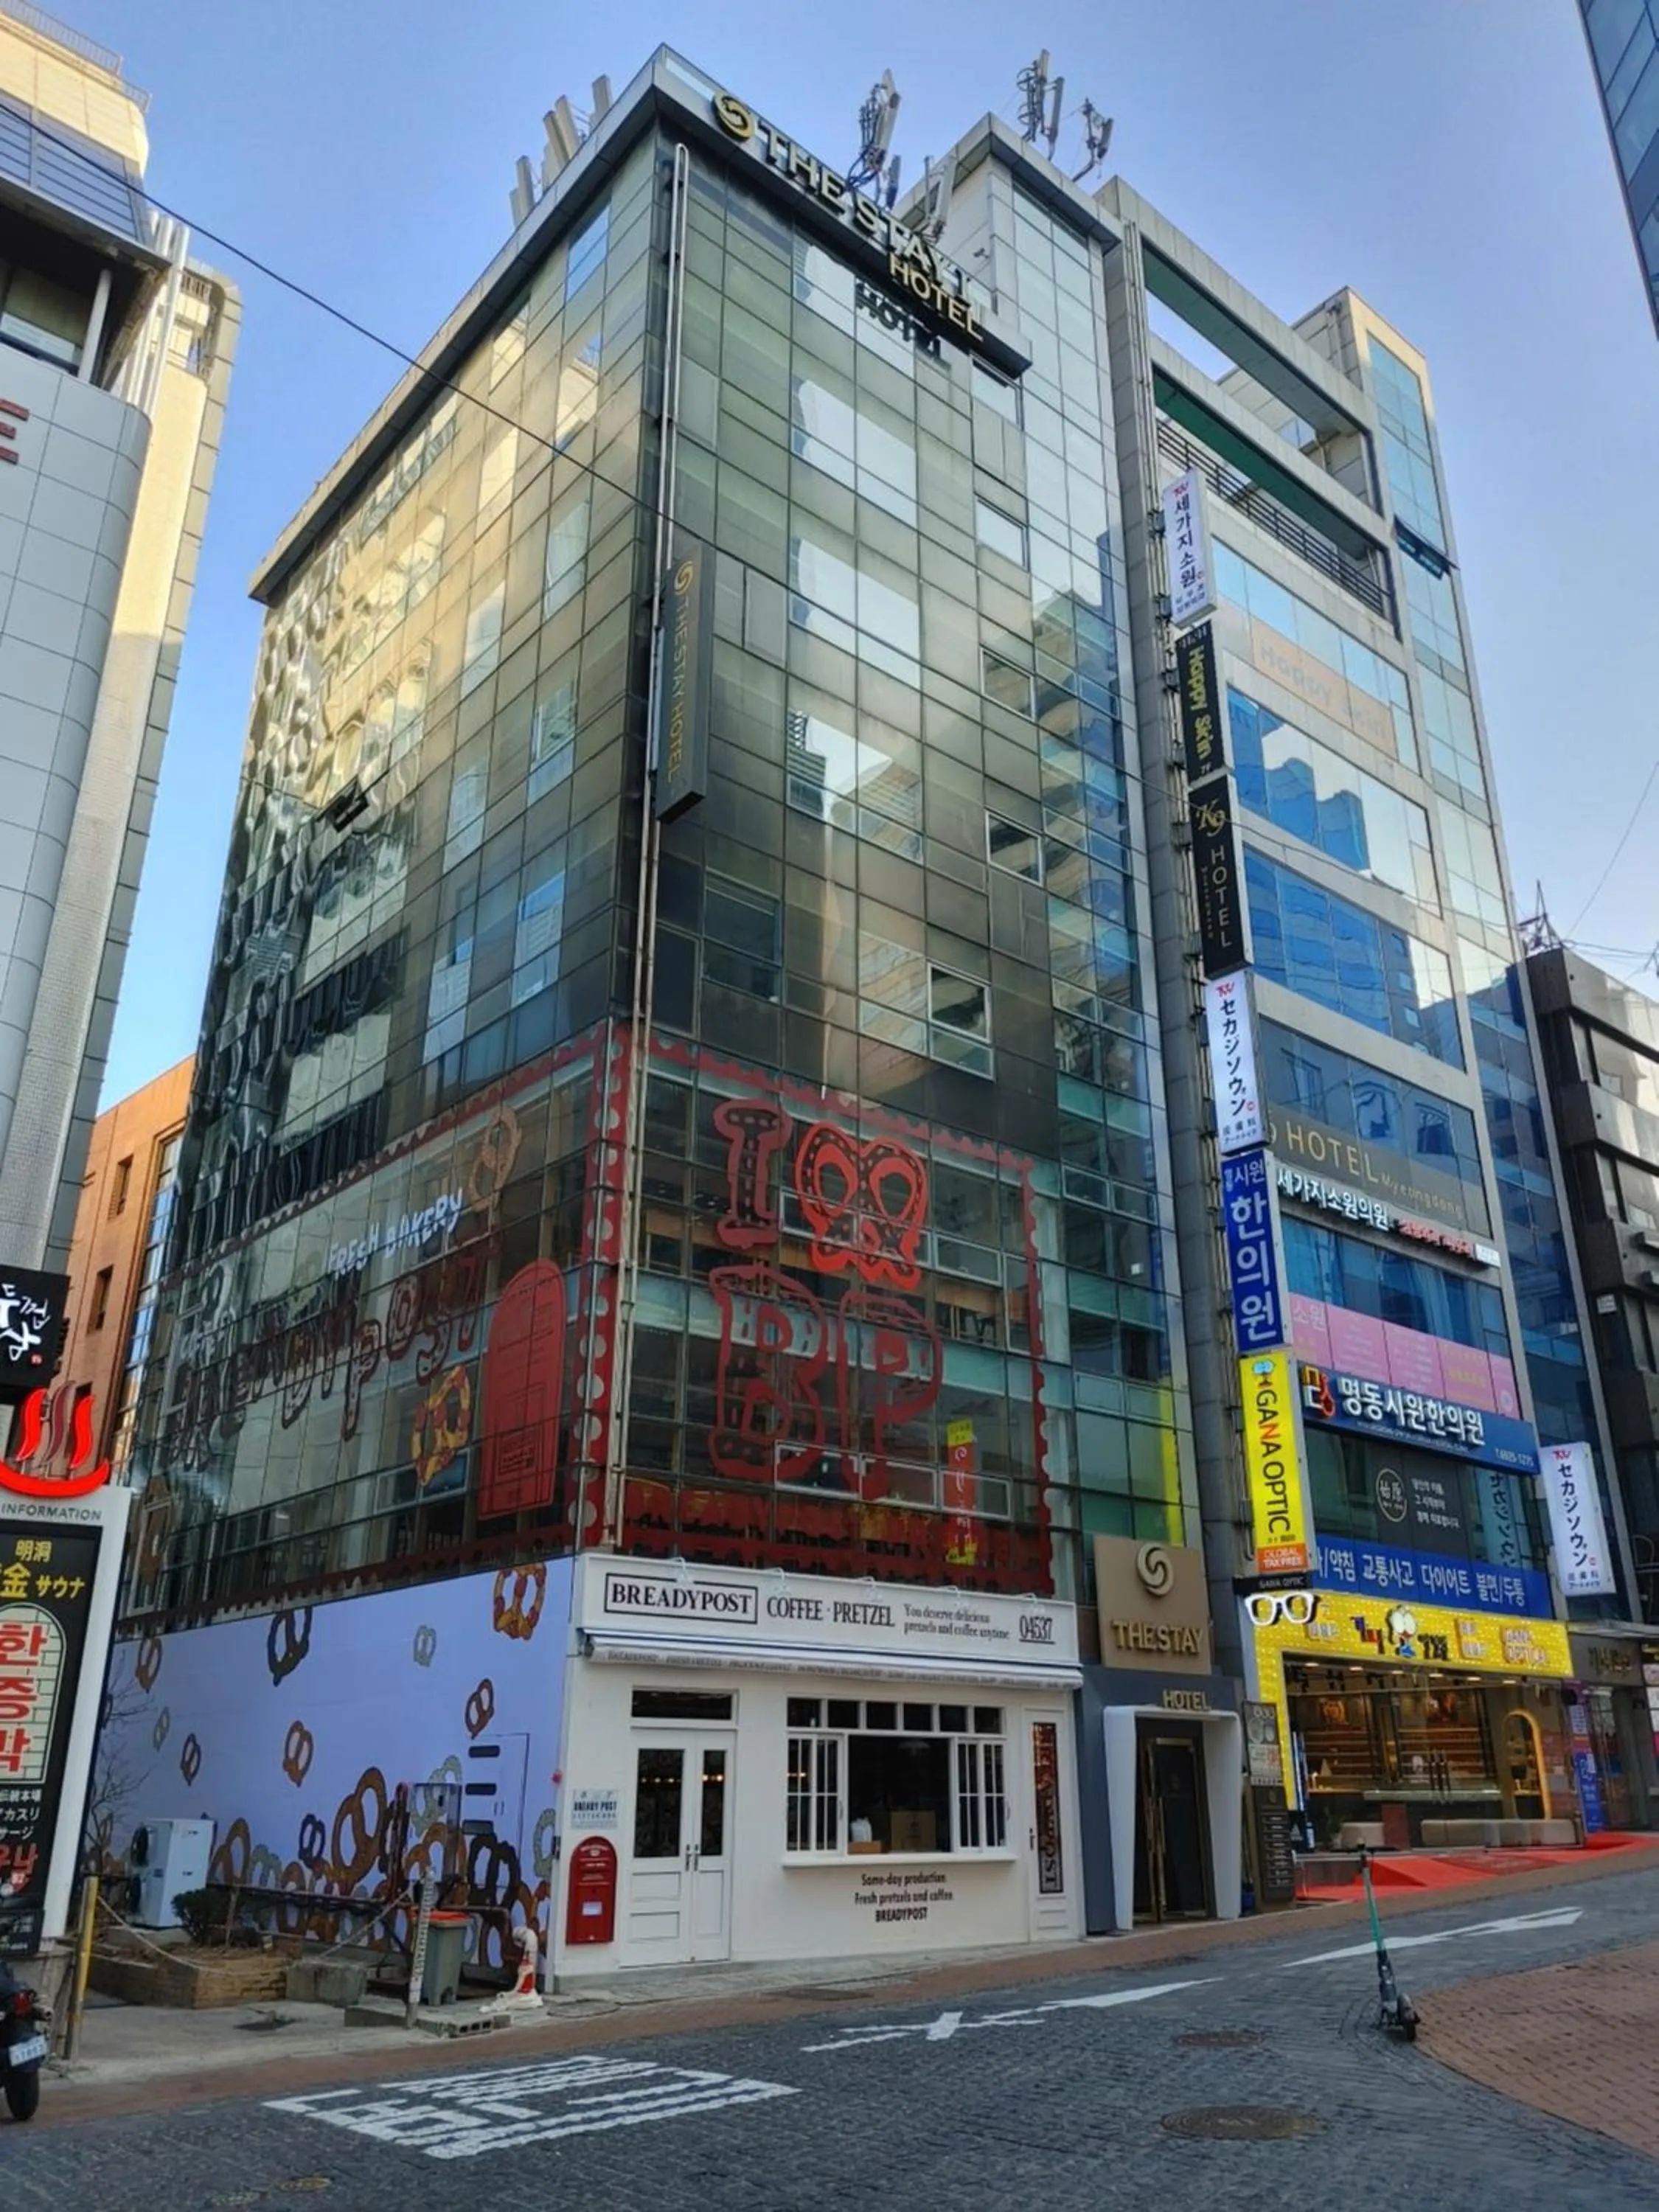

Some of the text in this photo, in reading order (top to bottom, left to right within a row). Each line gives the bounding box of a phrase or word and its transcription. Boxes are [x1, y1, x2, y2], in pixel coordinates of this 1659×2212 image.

[889, 251, 984, 342] HOTEL
[1174, 493, 1197, 590] 세가지소원
[668, 702, 684, 783] HOTEL
[1211, 845, 1233, 947] HOTEL
[1286, 1120, 1380, 1182] HOTEL
[1234, 1158, 1265, 1186] 시원
[1278, 1167, 1391, 1232] 세가지소원의원
[1230, 1191, 1277, 1342] 한의원
[1256, 1389, 1282, 1458] GANA
[1338, 1376, 1486, 1446] 명동시원한의원
[1, 1503, 102, 1520] INFORMATION
[1263, 1461, 1290, 1534] OPTIC
[15, 1539, 52, 1562] 明洞
[36, 1574, 86, 1599] サウナ
[1362, 1554, 1415, 1588] 교통사고
[1420, 1563, 1472, 1598] 다이어트
[611, 1582, 752, 1615] BREADYPOST
[766, 1596, 896, 1627] COFFEE PRETZEL
[903, 1603, 922, 1618] You
[938, 1623, 953, 1636] and
[954, 1624, 979, 1637] coffee
[1019, 1615, 1054, 1641] 04537
[1162, 1688, 1212, 1711] HOTEL
[861, 1871, 902, 1888] Same-day
[855, 1891, 877, 1905] Fresh
[912, 1888, 928, 1902] and
[875, 1906, 928, 1923] BREADYPOST
